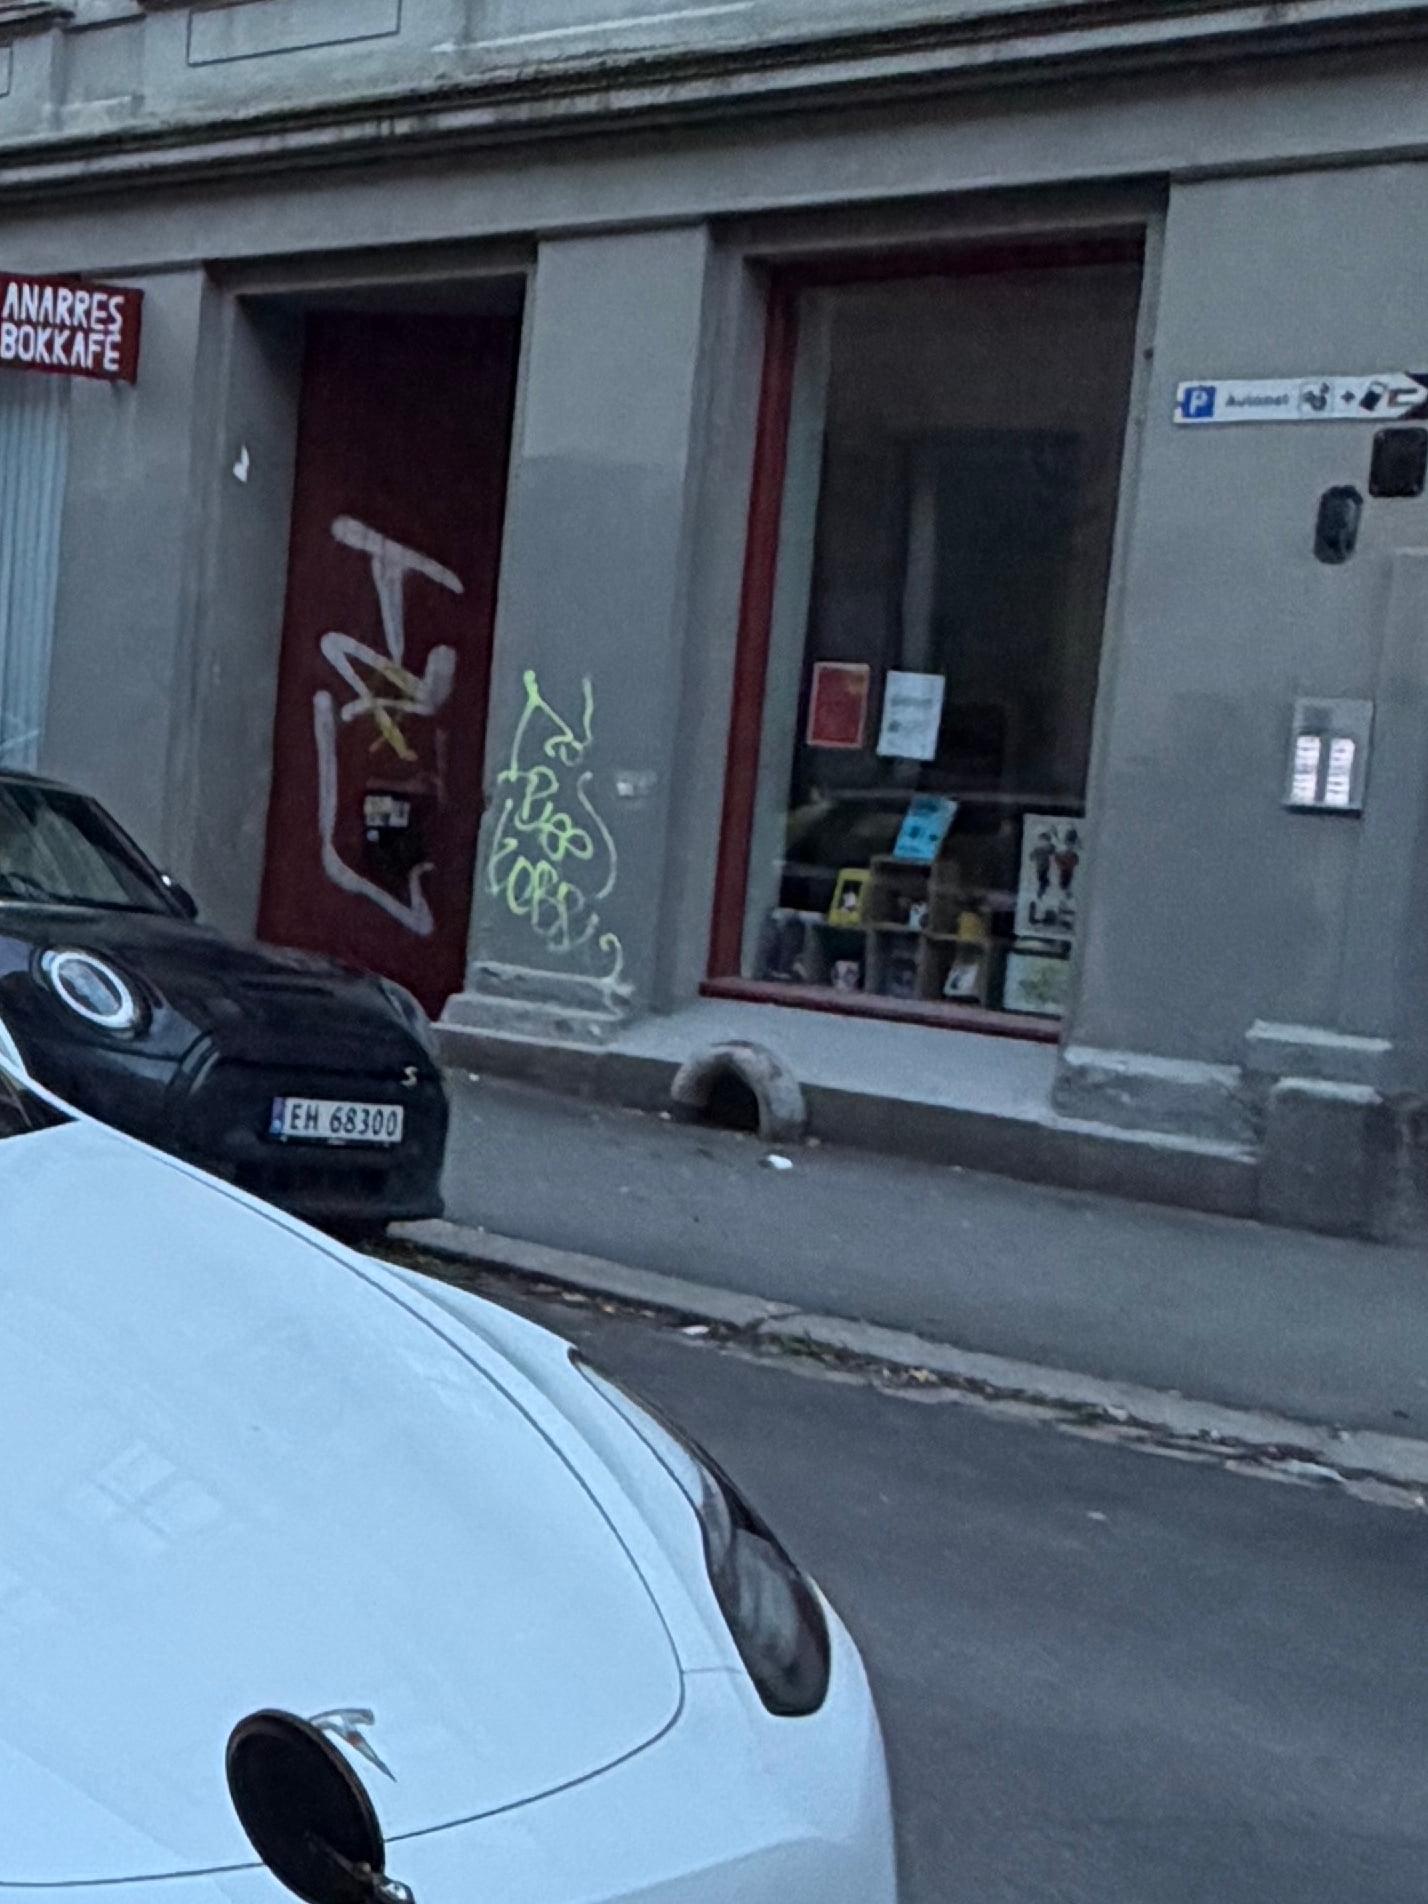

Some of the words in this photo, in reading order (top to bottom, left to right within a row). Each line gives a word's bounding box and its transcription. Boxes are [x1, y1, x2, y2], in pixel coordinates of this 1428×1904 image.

[1, 281, 126, 331] ANARRES
[1189, 389, 1209, 416] P
[290, 1103, 320, 1132] EH
[329, 1106, 399, 1137] 68300
